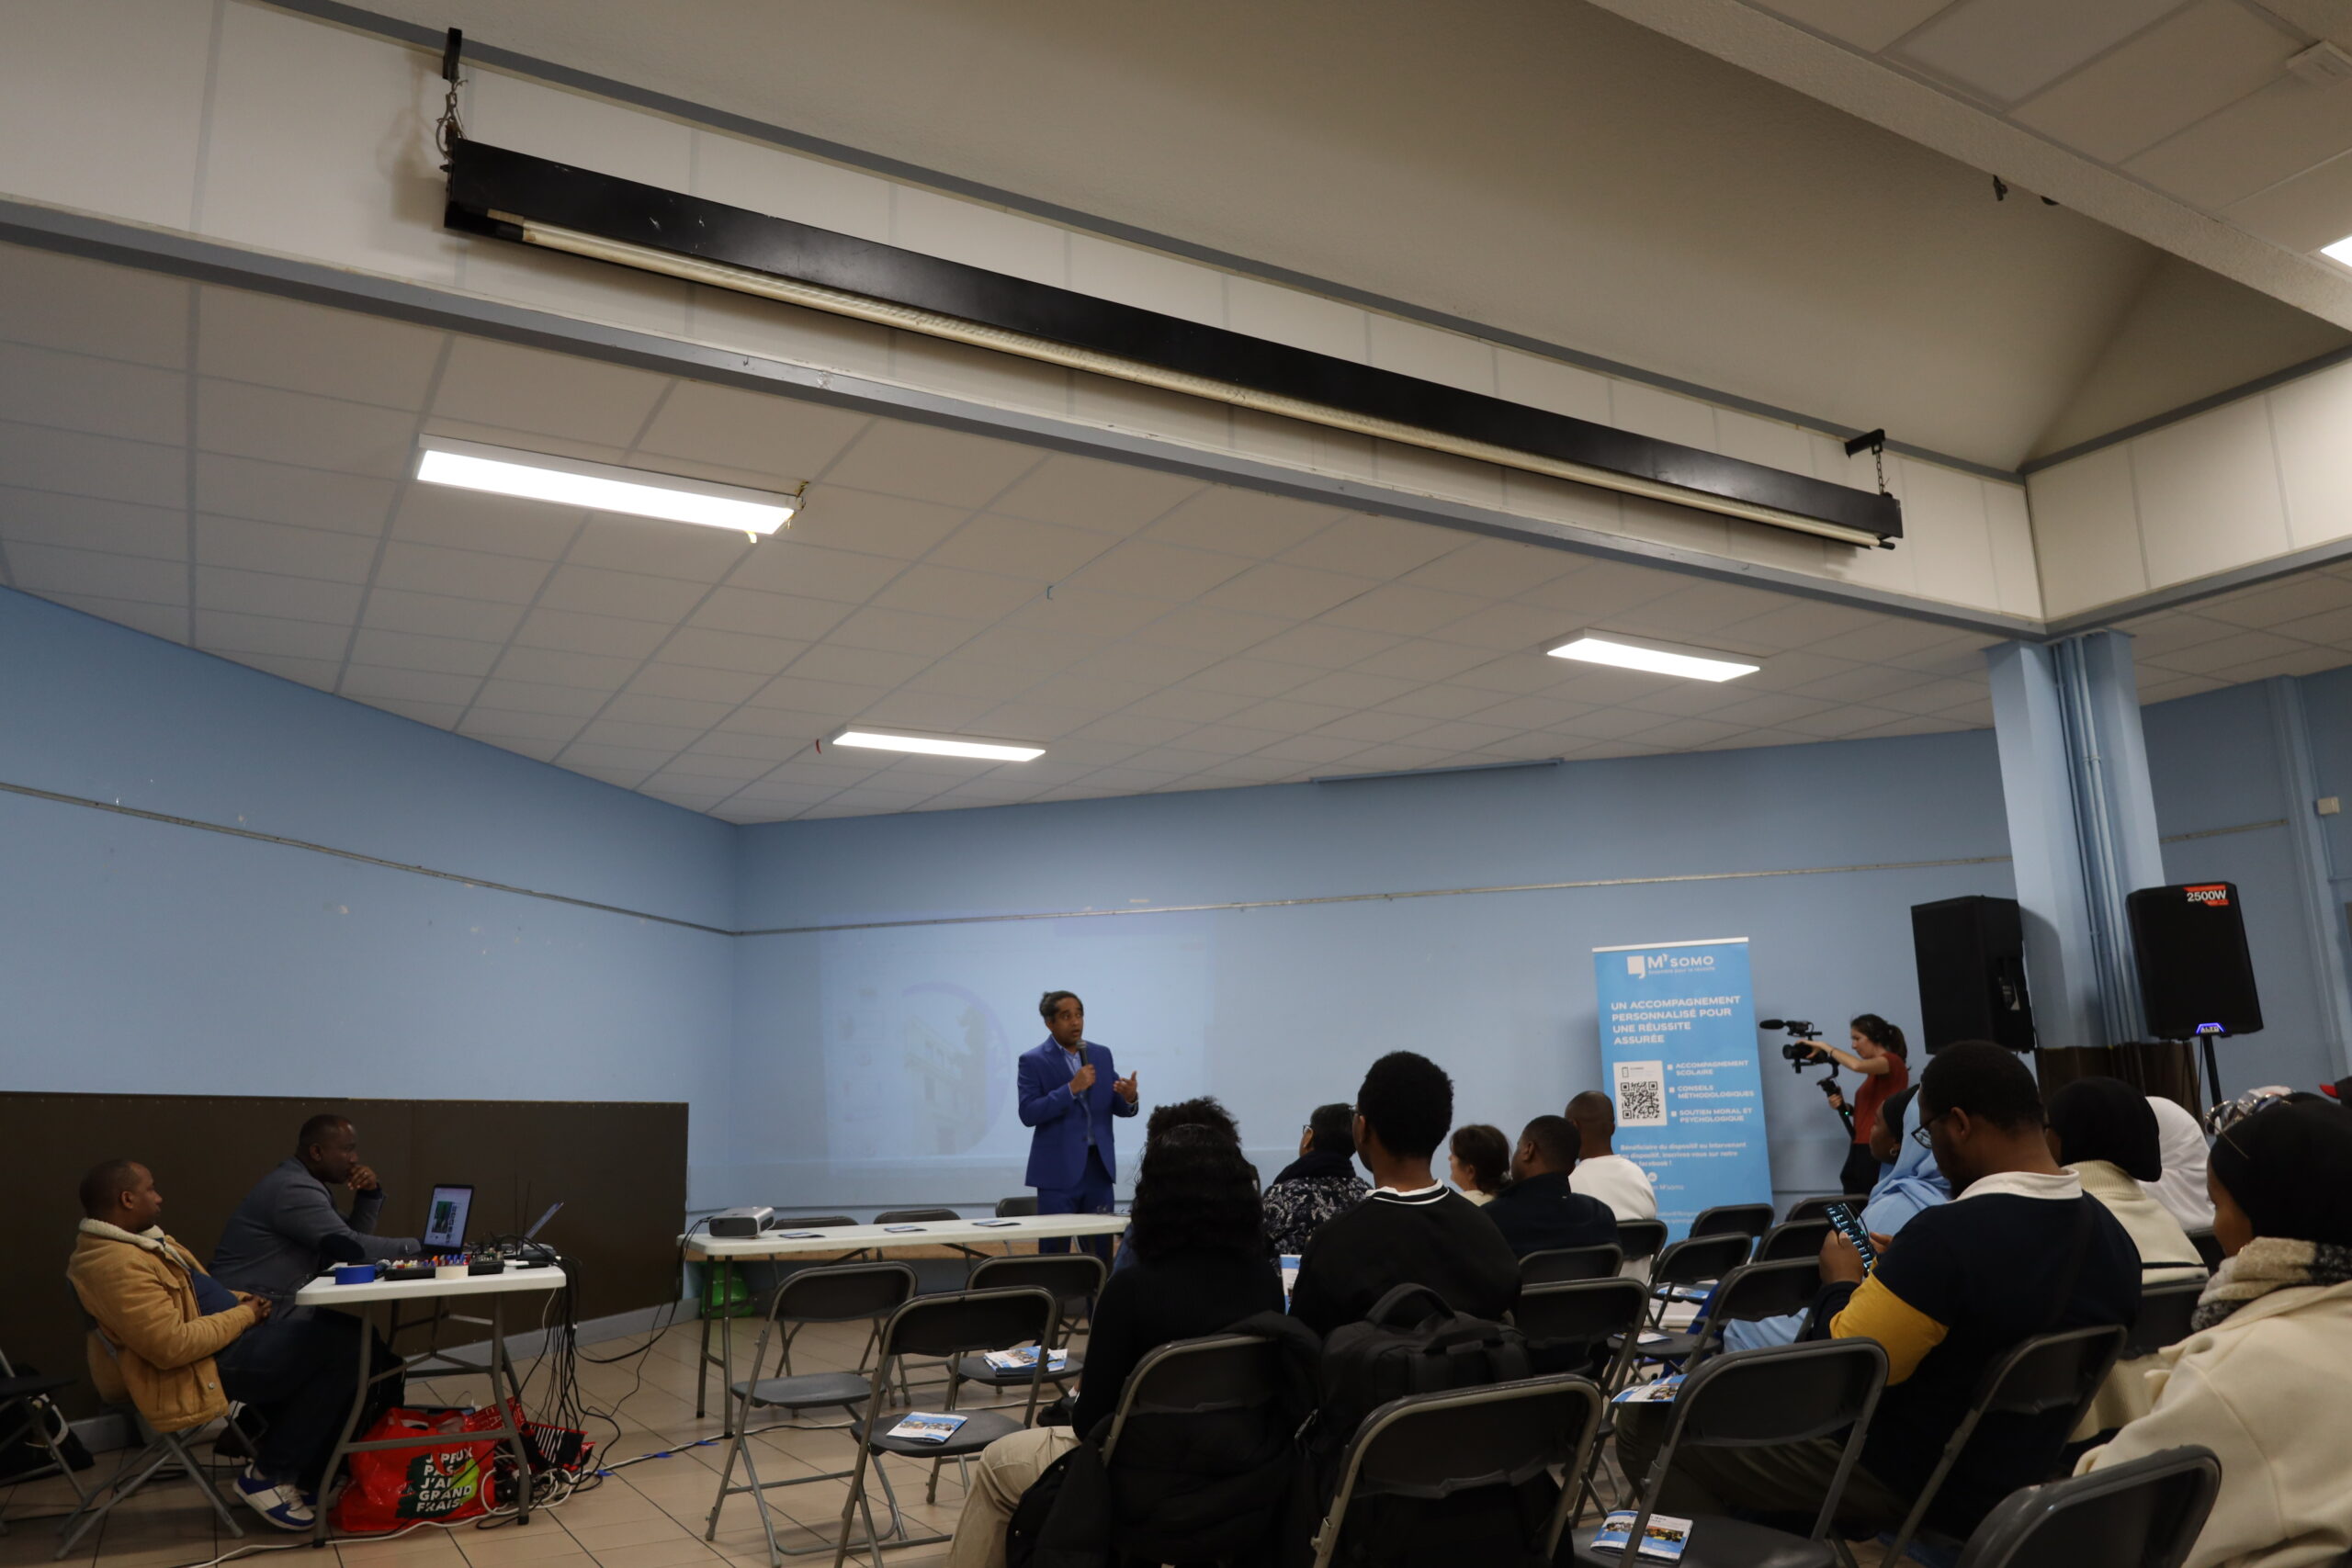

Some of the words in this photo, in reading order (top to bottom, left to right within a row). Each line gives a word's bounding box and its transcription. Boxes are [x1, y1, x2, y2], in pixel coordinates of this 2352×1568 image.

[2187, 889, 2227, 903] 2500W
[1611, 1002, 1627, 1010] UN
[1630, 996, 1741, 1010] ACCOMPAGNEMENT
[1612, 1008, 1697, 1021] PERSONNALISÉ
[1700, 1008, 1732, 1018] POUR
[1612, 1024, 1635, 1033] UNE
[1638, 1021, 1691, 1032] RÉUSSITE
[1614, 1033, 1665, 1045] ASSURÉE
[425, 1447, 473, 1464] JPEUX
[420, 1477, 452, 1490] J'AI
[419, 1484, 472, 1501] GRAND
